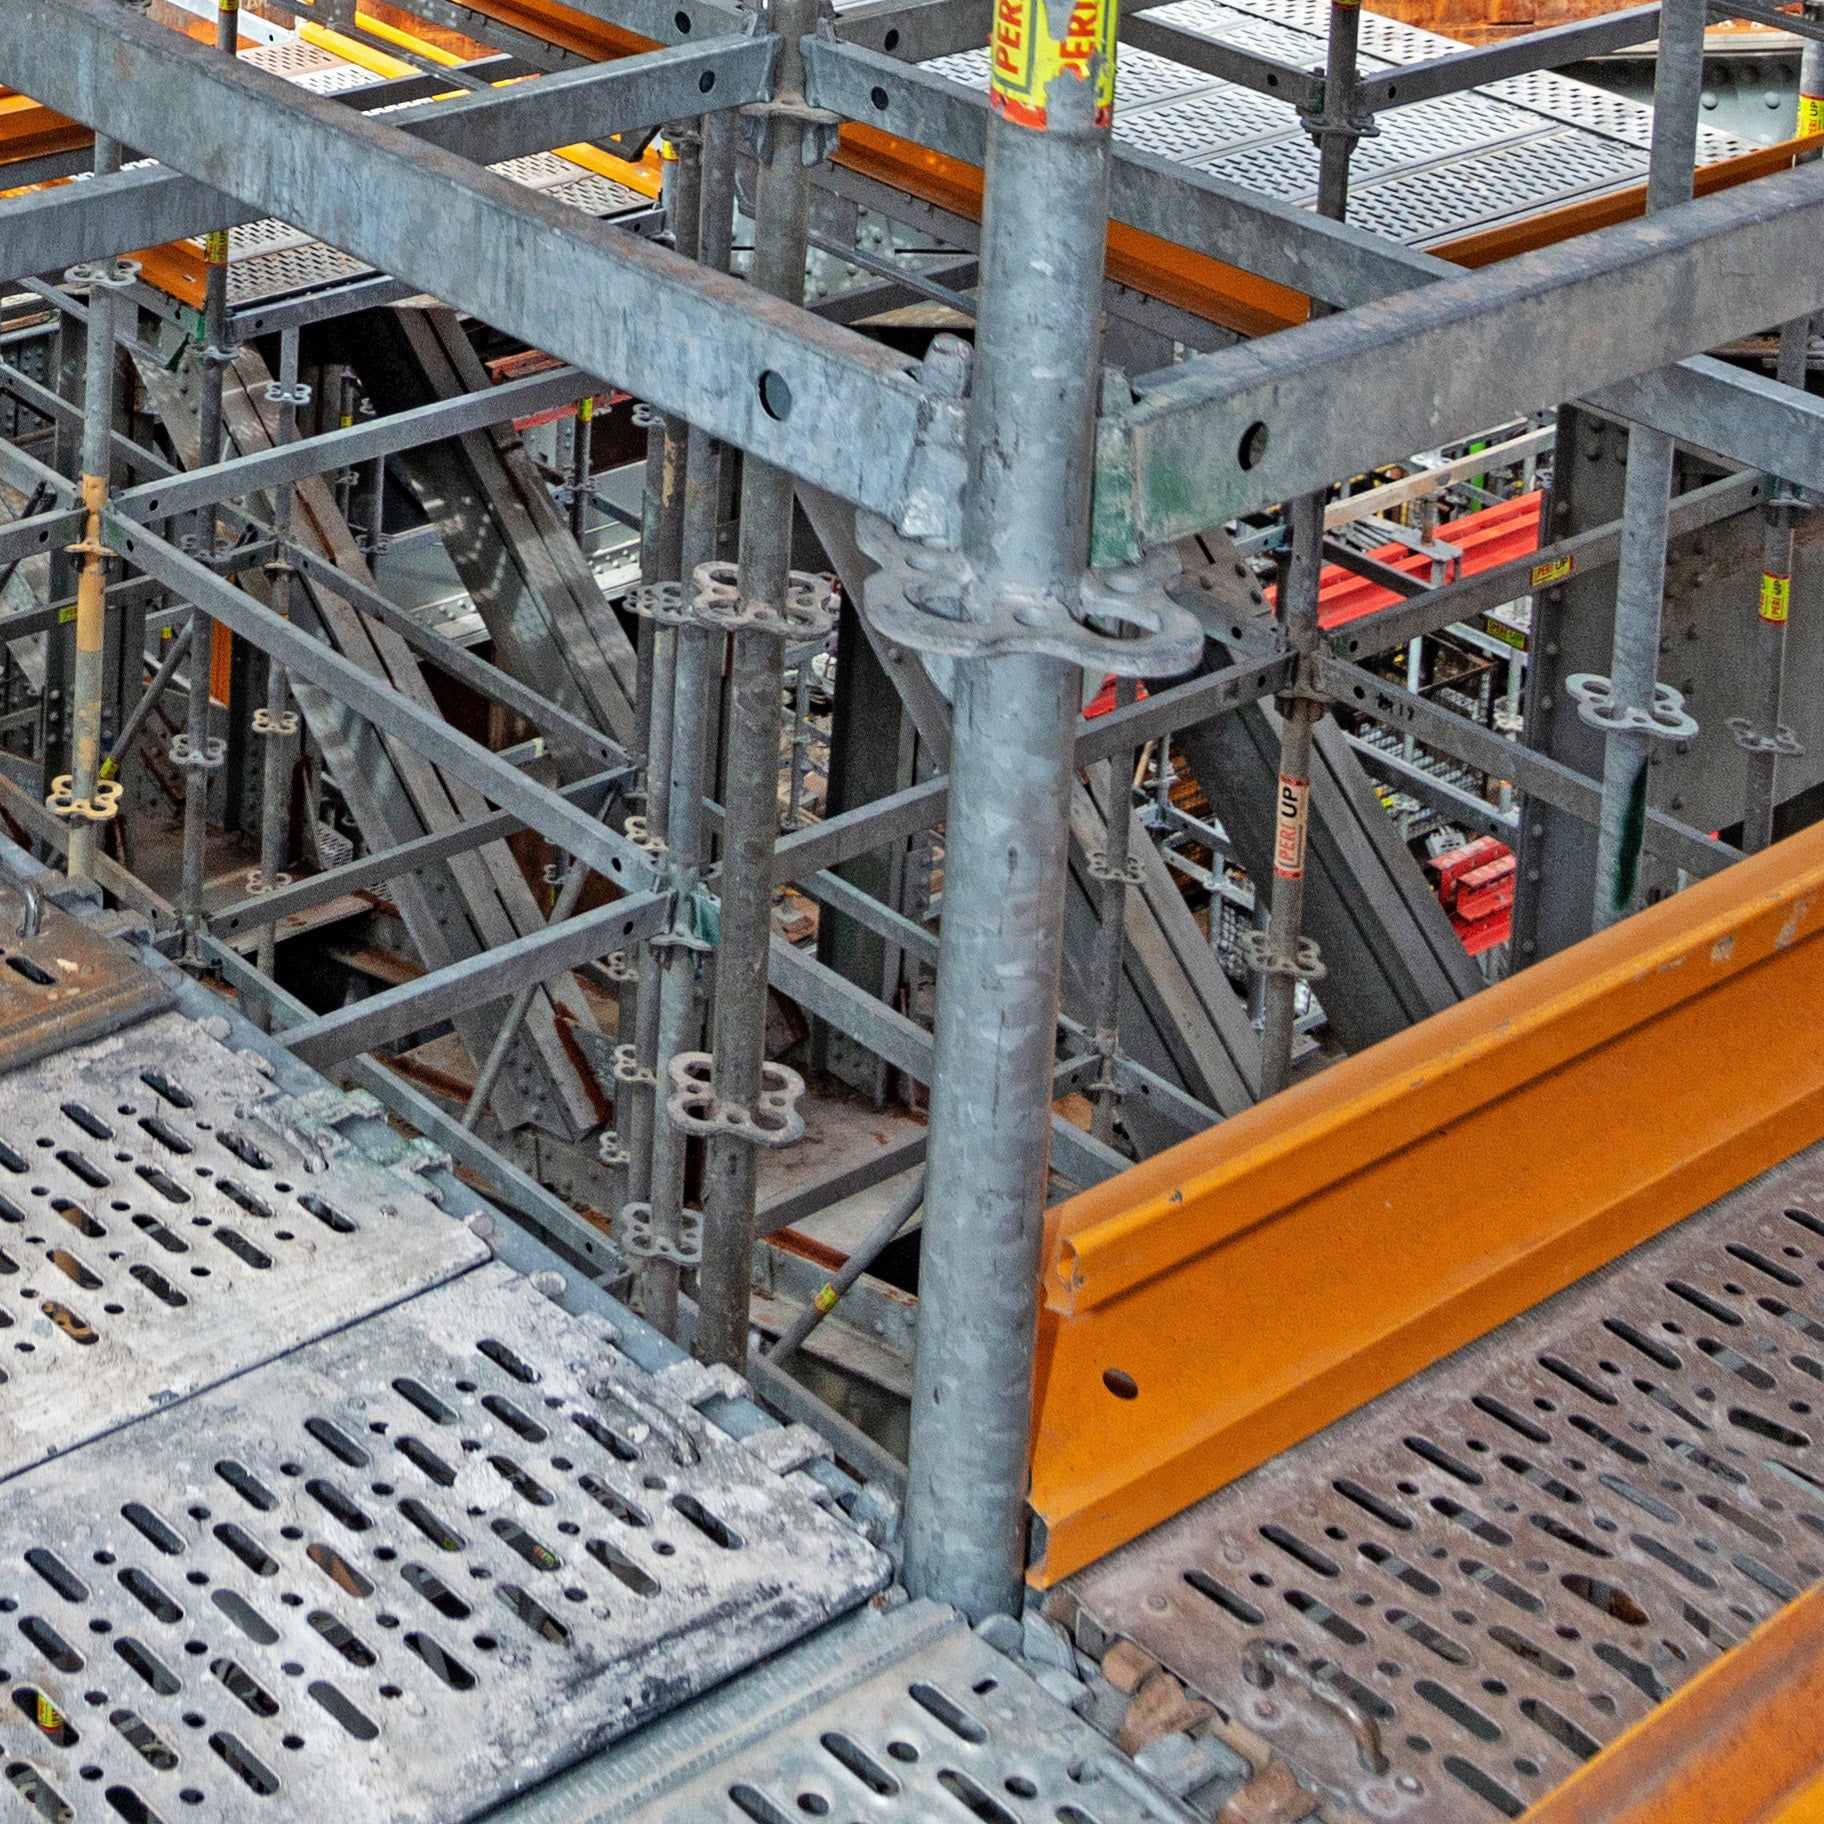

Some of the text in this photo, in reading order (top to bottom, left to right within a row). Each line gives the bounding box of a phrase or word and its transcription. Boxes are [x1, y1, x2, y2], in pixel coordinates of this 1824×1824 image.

[1809, 101, 1819, 117] UP
[1278, 785, 1299, 862] PERI UP
